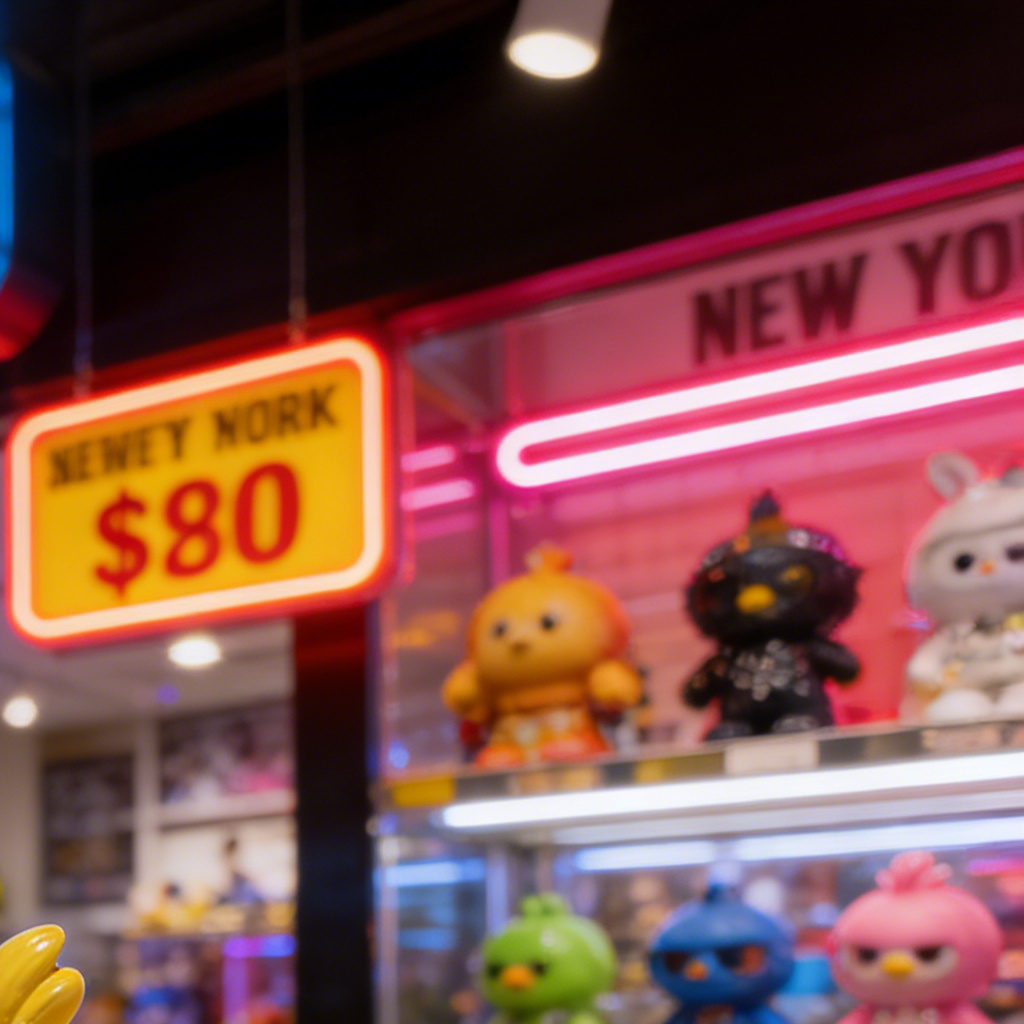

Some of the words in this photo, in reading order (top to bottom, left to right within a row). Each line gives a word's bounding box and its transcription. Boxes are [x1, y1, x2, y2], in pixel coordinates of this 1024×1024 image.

[692, 253, 868, 363] NEW
[899, 215, 1024, 315] YO
[94, 463, 299, 600] $80
